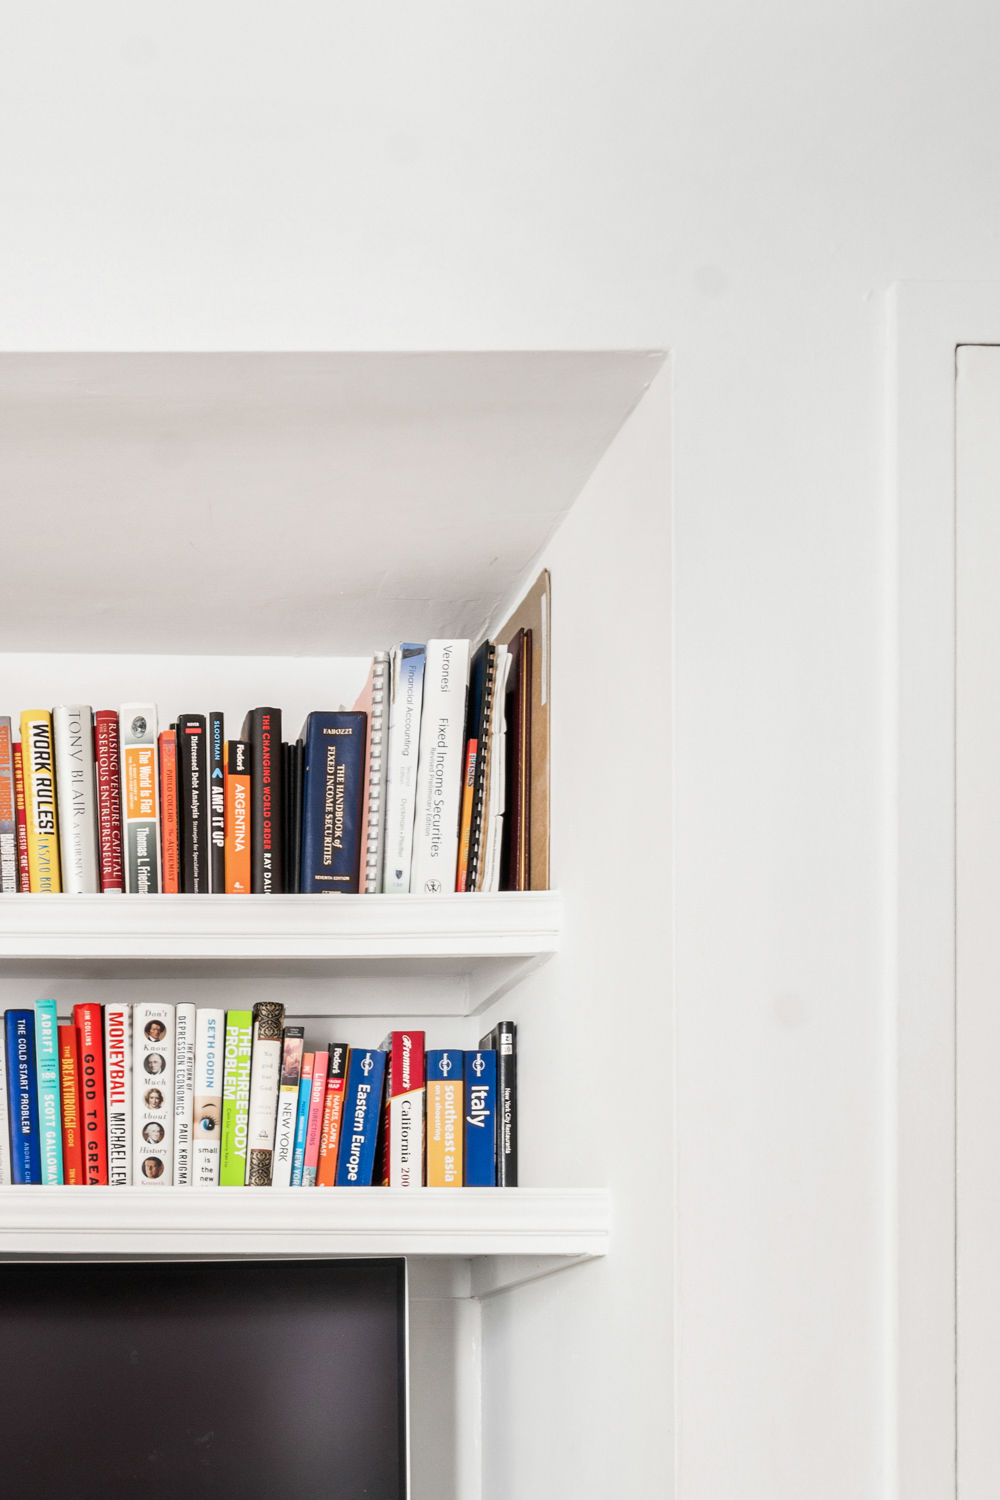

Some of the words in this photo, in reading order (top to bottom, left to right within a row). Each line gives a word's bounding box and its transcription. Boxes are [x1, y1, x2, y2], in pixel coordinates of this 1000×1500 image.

[440, 645, 452, 692] Veronesi
[33, 724, 52, 771] WORK
[68, 710, 82, 761] TONY
[109, 723, 117, 770] RAISING
[437, 718, 449, 747] Fixed
[99, 733, 108, 780] SERIOUS
[139, 750, 151, 764] The
[139, 765, 151, 787] World
[434, 752, 446, 795] Income
[468, 752, 478, 788] PHYSICS
[36, 778, 54, 834] RULES!
[71, 770, 85, 815] BLAIR
[110, 775, 119, 826] VENTURE
[140, 799, 152, 813] Flat
[191, 789, 199, 818] Analysis
[211, 786, 223, 812] AMP
[100, 785, 111, 873] ENTREPRENEUR
[212, 816, 223, 827] IT
[234, 783, 245, 851] ARGENTINA
[430, 799, 444, 857] Securities
[112, 830, 121, 877] CAPITAL
[212, 831, 224, 846] UP
[17, 1019, 25, 1034] THE
[41, 1013, 52, 1052] ADRIFT
[207, 1019, 215, 1048] SETH
[238, 1026, 252, 1056] THE
[18, 1038, 26, 1060] COLD
[108, 1012, 124, 1105] MONEYBALL
[223, 1026, 239, 1099] PROBLEM
[19, 1063, 28, 1090] START
[84, 1054, 95, 1099] GOOD
[206, 1052, 214, 1087] GODIN
[312, 1073, 323, 1102] Lisbon
[44, 1094, 55, 1126] SCOTT
[62, 1058, 76, 1127] BREAKTHROUGH
[234, 1060, 250, 1158] THREE-BODY
[353, 1084, 370, 1131] Eastern
[466, 1086, 489, 1126] Italy
[20, 1093, 30, 1133] PROBLEM
[86, 1109, 97, 1131] TO
[178, 1123, 188, 1143] PAUL
[282, 1102, 291, 1128] NEW
[309, 1108, 318, 1145] DIRECTIONS
[401, 1100, 410, 1162] California
[444, 1085, 457, 1152] southeast
[110, 1112, 125, 1162] MICHAEL
[278, 1131, 289, 1161] YORK
[45, 1131, 58, 1186] GALLOWAY
[347, 1135, 364, 1180] Europe
[444, 1155, 456, 1181] asia
